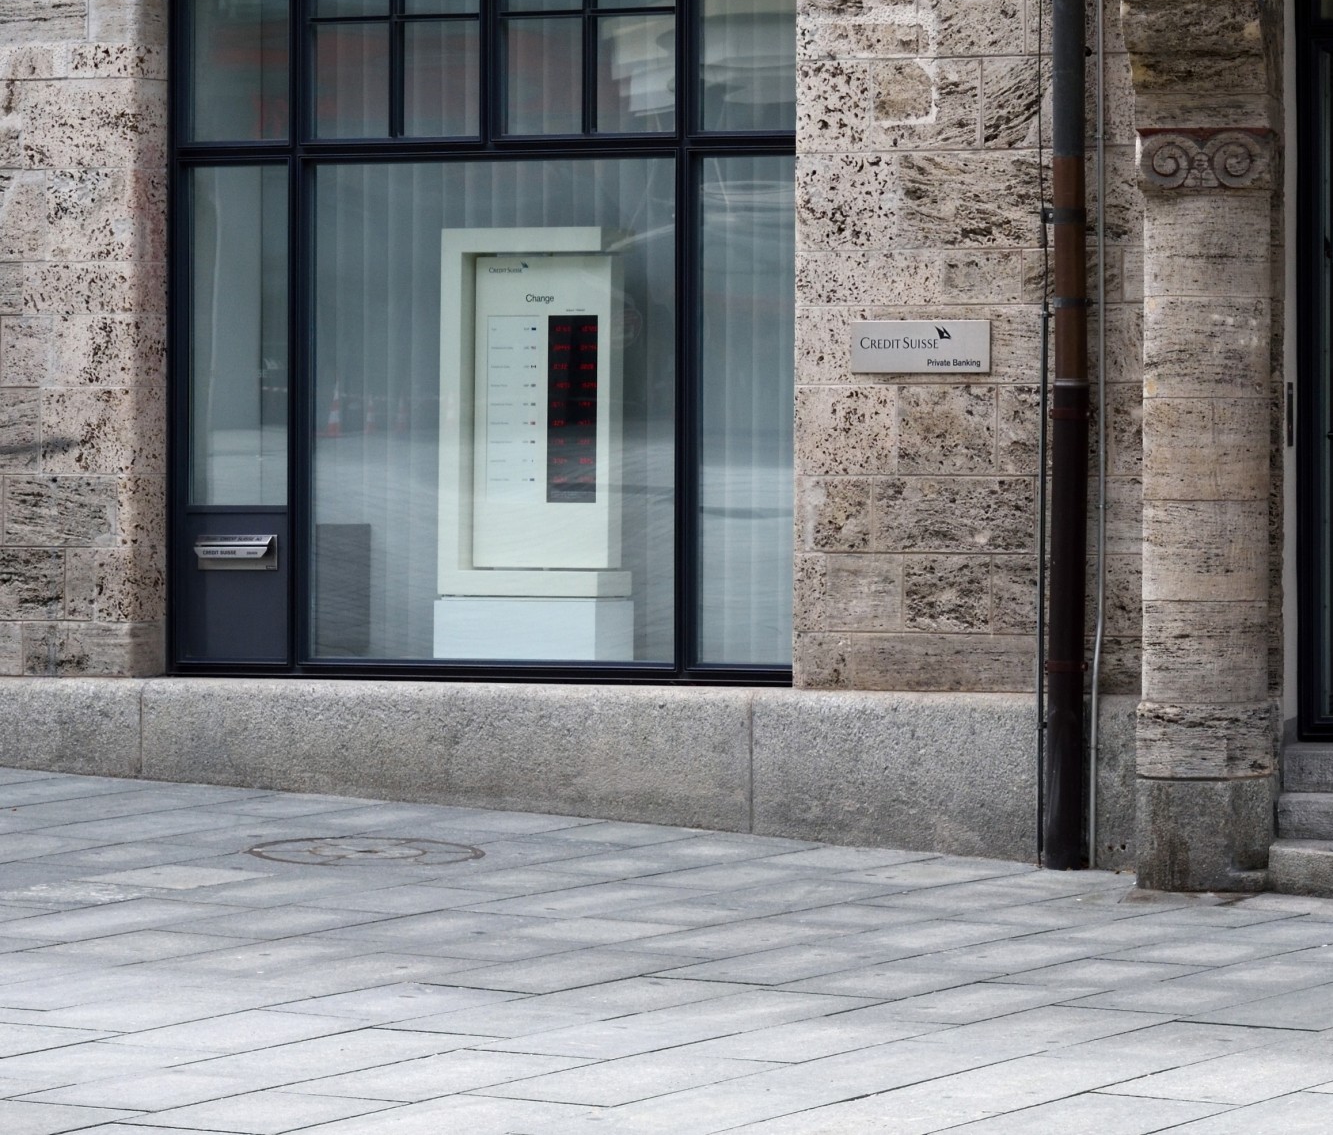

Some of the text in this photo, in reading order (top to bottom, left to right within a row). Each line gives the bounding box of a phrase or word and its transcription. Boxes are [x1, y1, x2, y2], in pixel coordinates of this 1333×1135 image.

[525, 293, 555, 305] Change
[859, 336, 939, 350] CREDIT SUISSE
[927, 358, 981, 368] Private Banking
